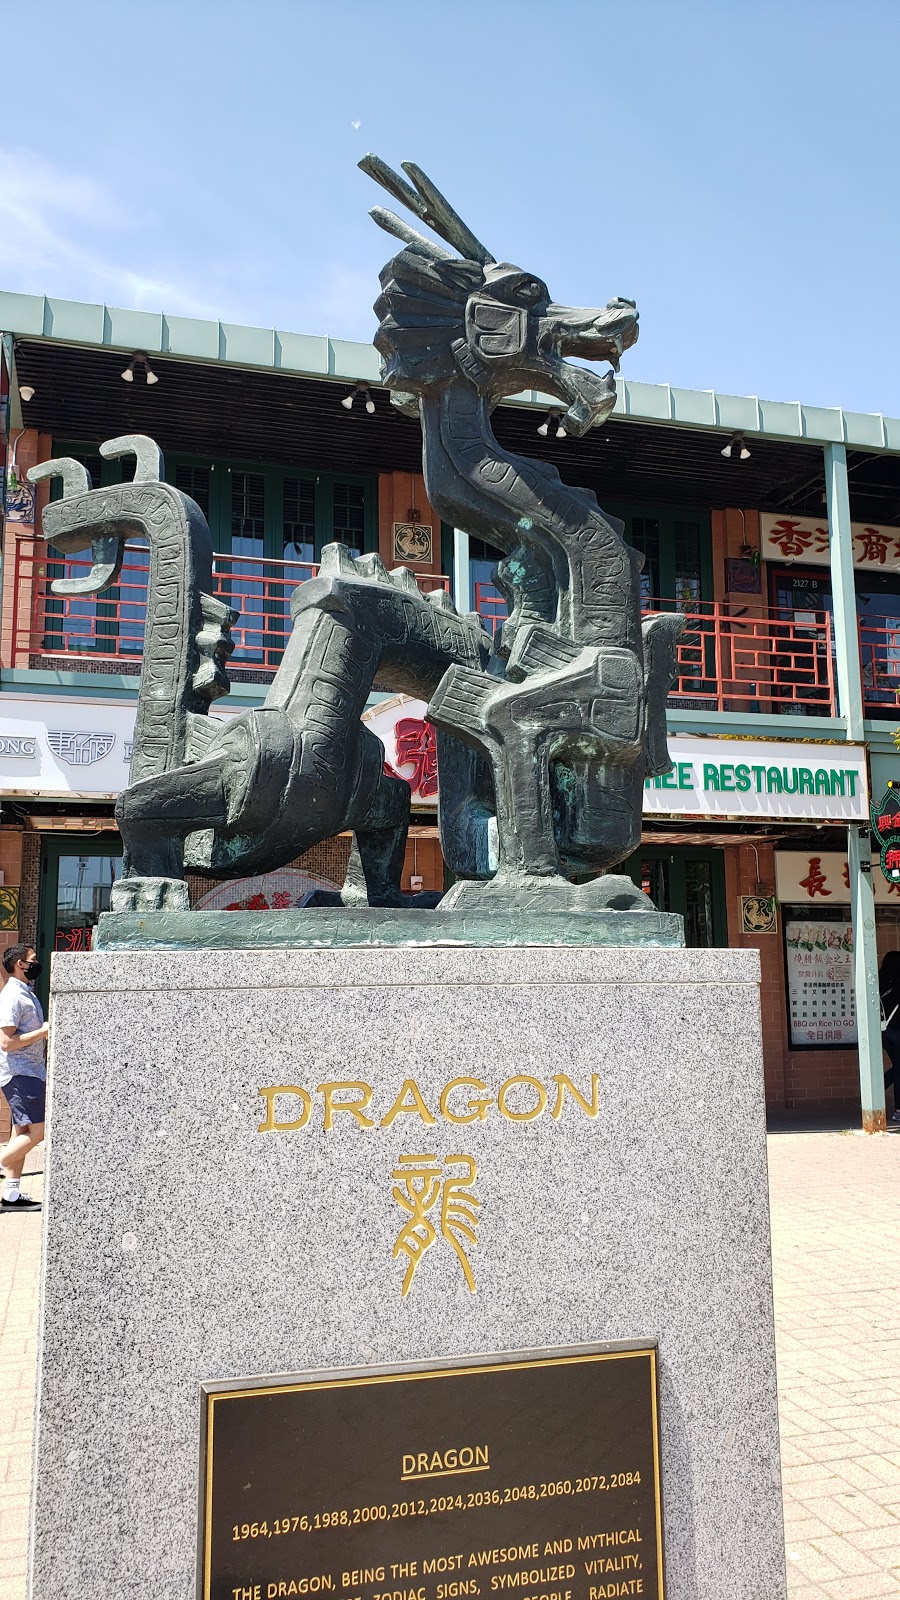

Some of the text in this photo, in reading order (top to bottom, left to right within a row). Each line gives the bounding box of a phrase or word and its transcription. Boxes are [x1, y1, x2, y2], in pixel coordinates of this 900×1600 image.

[793, 578, 818, 588] 2127 B
[702, 763, 859, 797] RESTAURANT
[793, 1020, 808, 1028] BBQ
[843, 1019, 855, 1027] GO
[257, 1073, 601, 1134] DRAGON
[402, 1445, 490, 1475] DRAGON
[232, 1528, 642, 1600] THE DRAGON, BEING THE MOST AWESOME AND MYTHICAL
[436, 1579, 482, 1600] SIGNS,
[490, 1564, 576, 1590] SYMBOLIZED
[584, 1553, 644, 1576] VITALITY,
[589, 1578, 644, 1600] RADIATE
